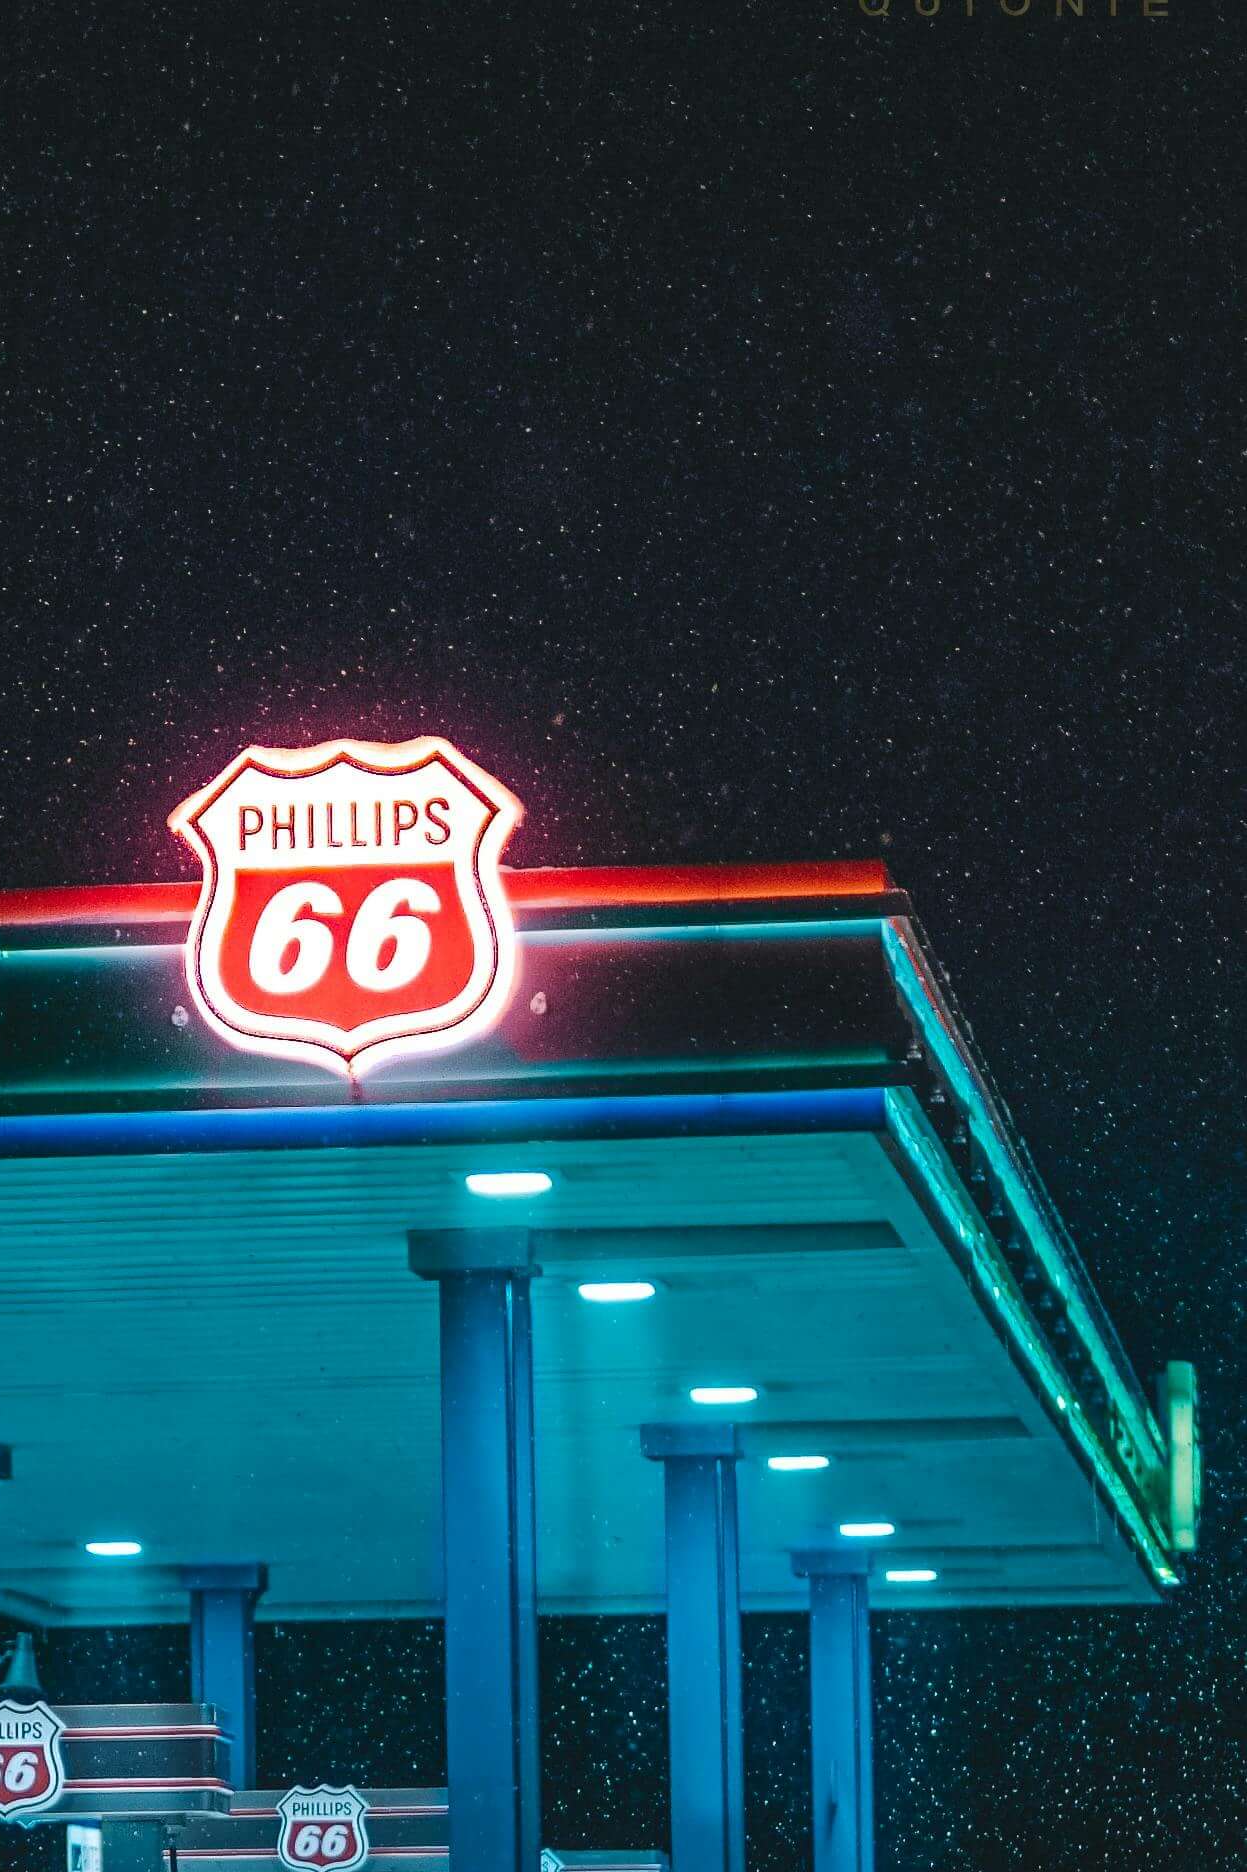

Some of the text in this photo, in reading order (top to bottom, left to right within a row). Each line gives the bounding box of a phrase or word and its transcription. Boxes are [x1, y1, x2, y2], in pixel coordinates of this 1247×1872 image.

[239, 797, 451, 850] PHILLIPS
[249, 878, 441, 995] 66
[292, 1801, 352, 1816] PHILLIPS
[294, 1824, 349, 1858] 66
